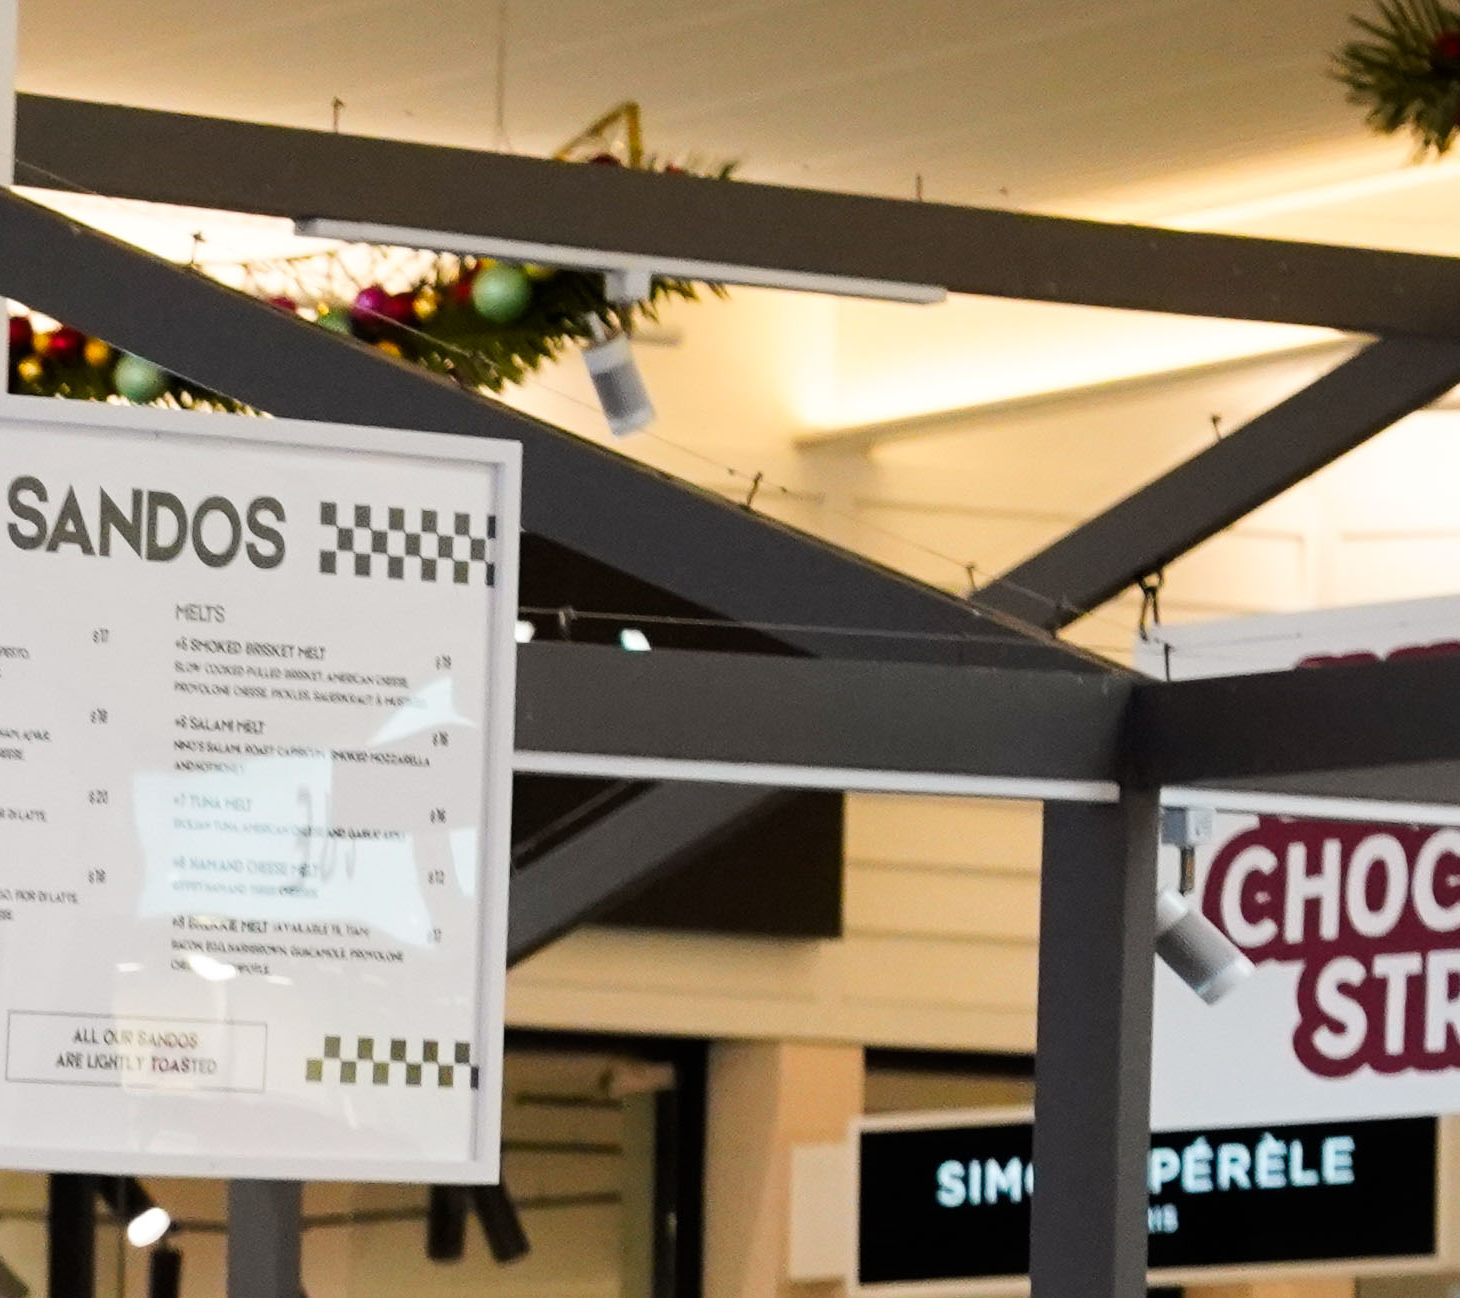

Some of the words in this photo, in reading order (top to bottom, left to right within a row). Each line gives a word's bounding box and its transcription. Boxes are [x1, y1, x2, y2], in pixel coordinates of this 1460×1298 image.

[7, 475, 287, 569] SANDOS
[175, 604, 226, 623] MELTS
[190, 639, 242, 655] SMOKED
[245, 641, 294, 658] BRISKET
[297, 645, 326, 661] MELT
[189, 718, 234, 734] SALAMI
[237, 720, 267, 735] MELT
[72, 1028, 99, 1045] ALL
[138, 1031, 199, 1050] SANDOS
[55, 1053, 82, 1070] ARE
[150, 1056, 217, 1076] TOASTED
[935, 1156, 1034, 1208] SIM
